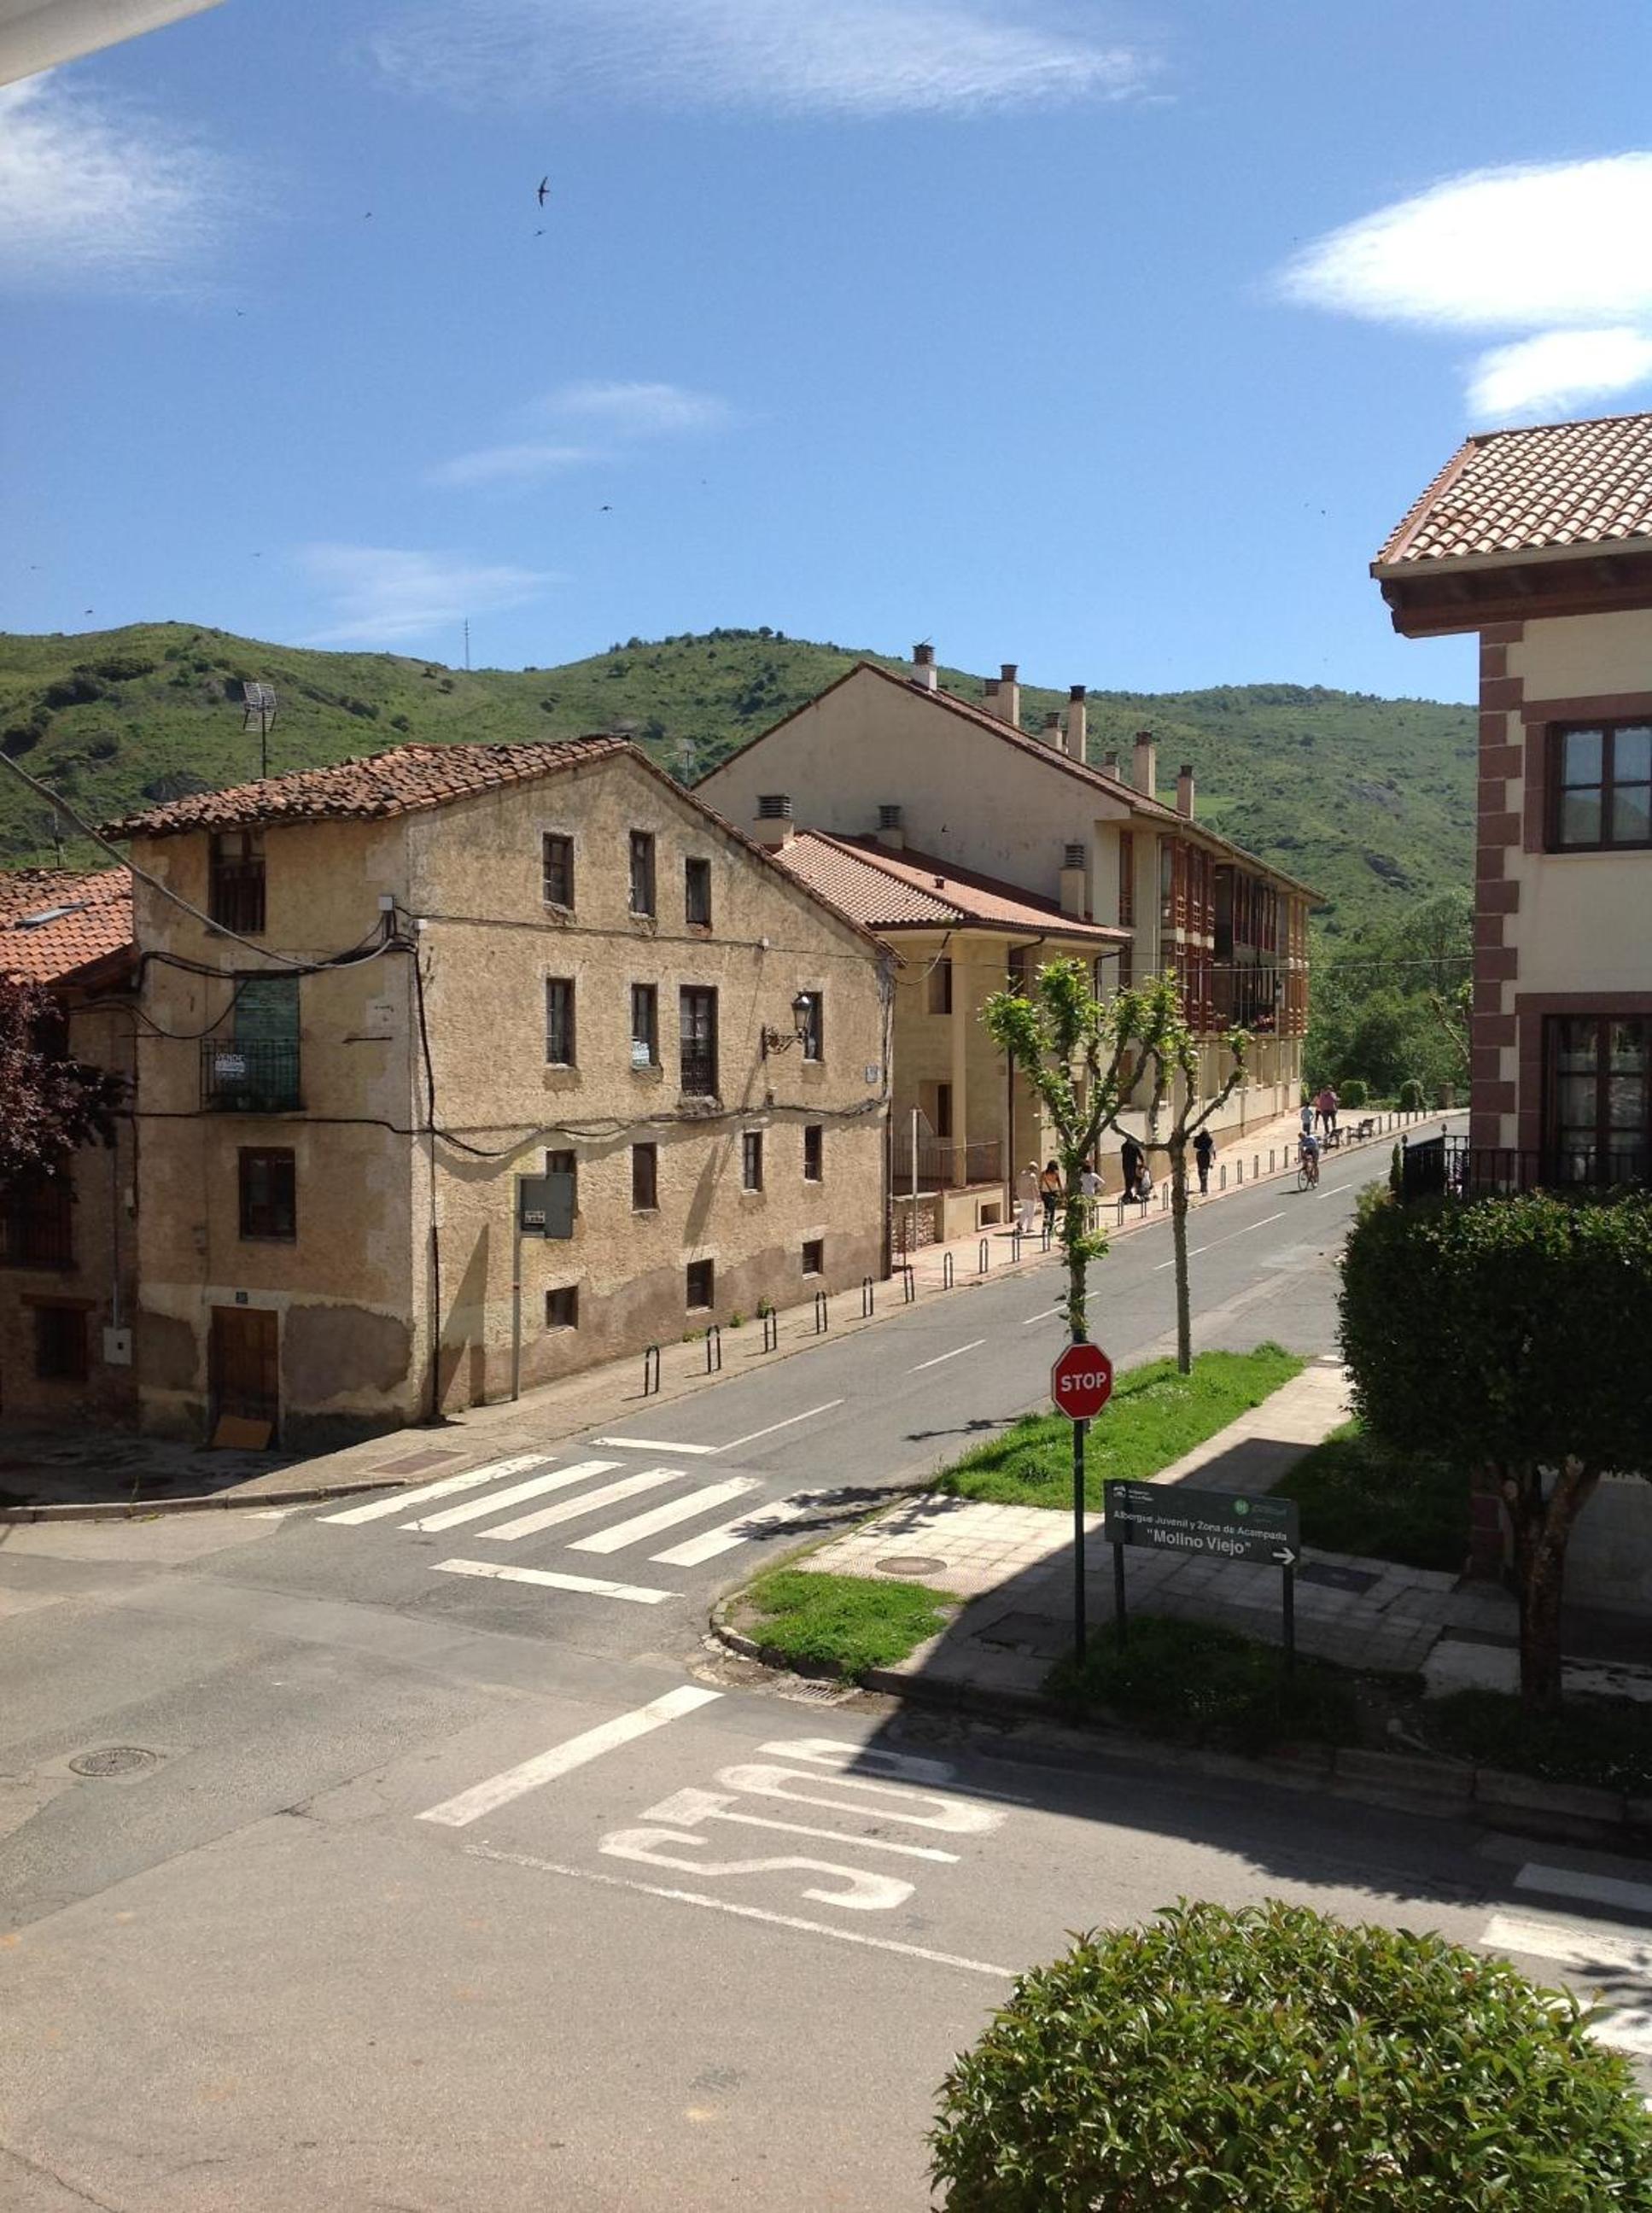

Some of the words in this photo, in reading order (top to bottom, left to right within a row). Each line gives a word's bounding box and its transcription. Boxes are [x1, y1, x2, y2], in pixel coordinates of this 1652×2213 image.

[1060, 1372, 1107, 1392] STOP
[1113, 1510, 1154, 1524] Albergue
[1155, 1516, 1189, 1528] Juvenil
[1189, 1521, 1196, 1531] y
[1197, 1521, 1221, 1533] Zona
[1223, 1525, 1235, 1534] de
[1237, 1527, 1287, 1542] Acampada
[1147, 1528, 1204, 1549] "Molino
[1208, 1536, 1252, 1556] Viejo"
[596, 1737, 1035, 1912] STOP
